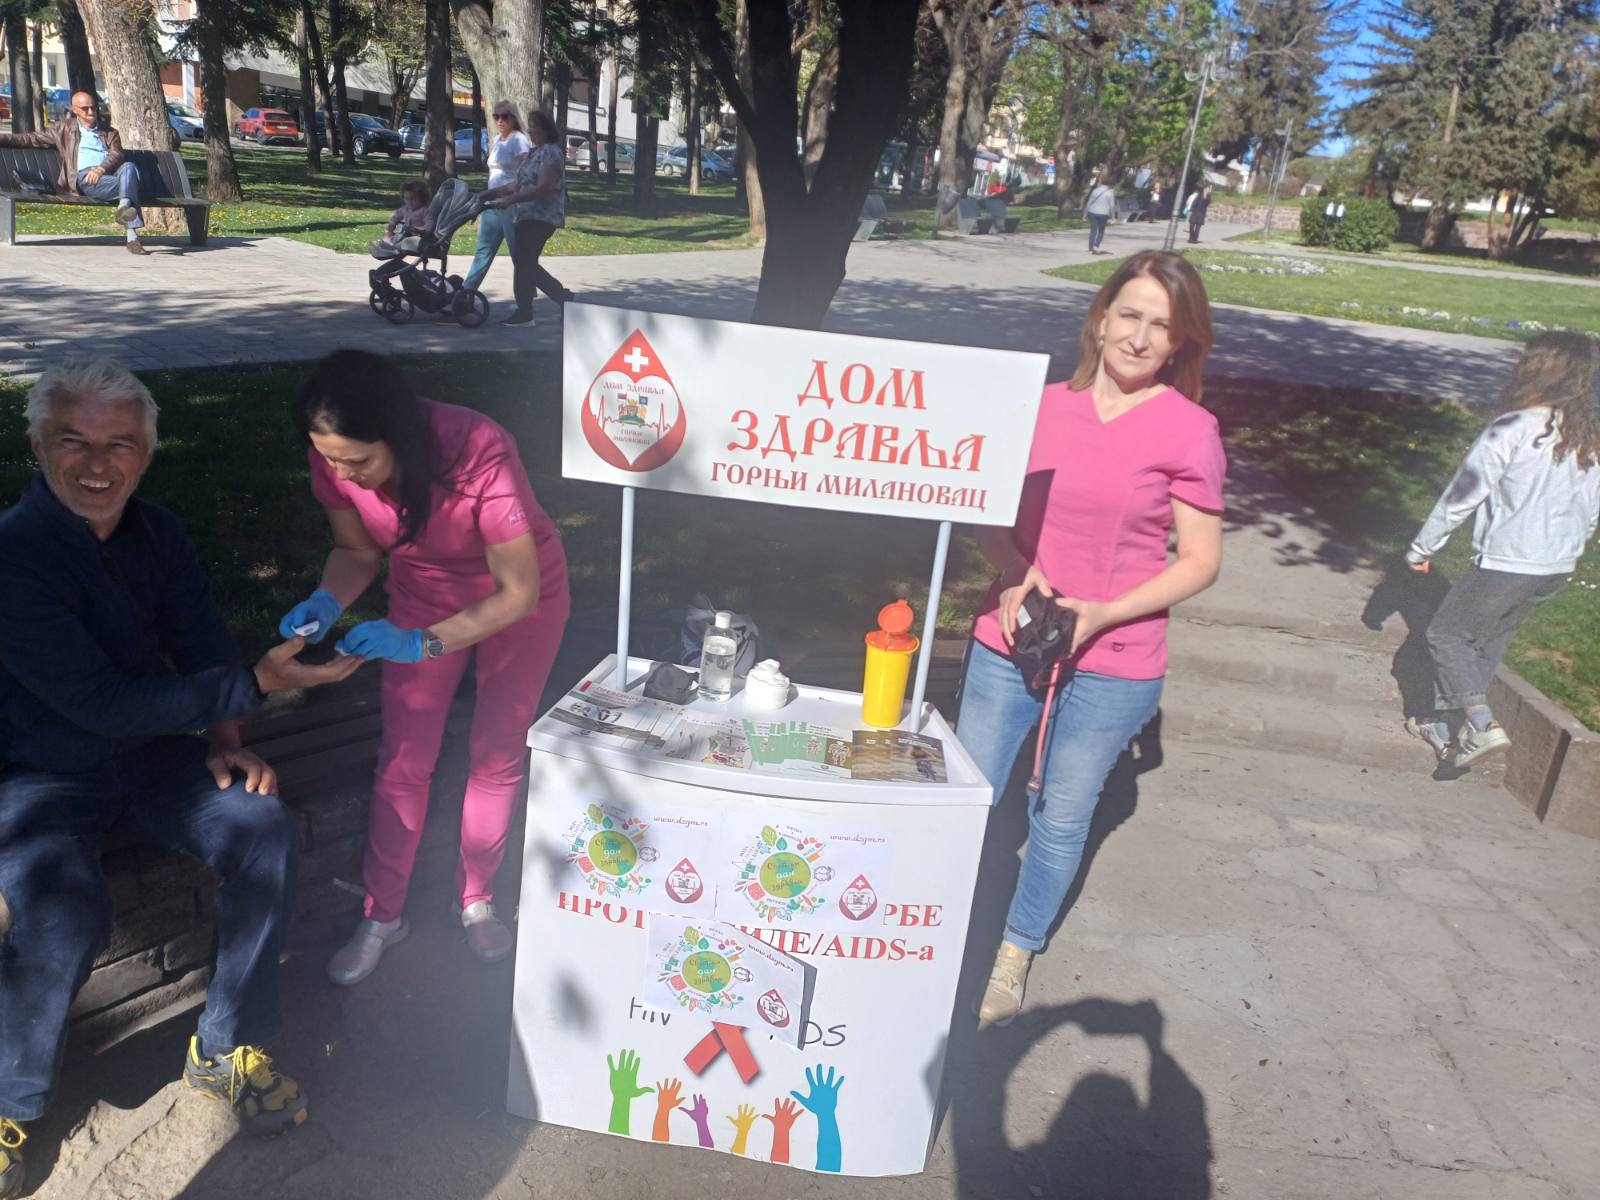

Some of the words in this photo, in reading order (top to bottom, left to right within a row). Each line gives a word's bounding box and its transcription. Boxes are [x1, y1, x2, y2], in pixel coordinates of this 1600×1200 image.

[797, 359, 927, 410] ДОМ
[727, 409, 987, 472] ЗДРАВЉА
[711, 462, 809, 491] ГОРЊИ
[816, 474, 988, 512] МИЛАНОВАЦ
[883, 903, 943, 927] РБЕ
